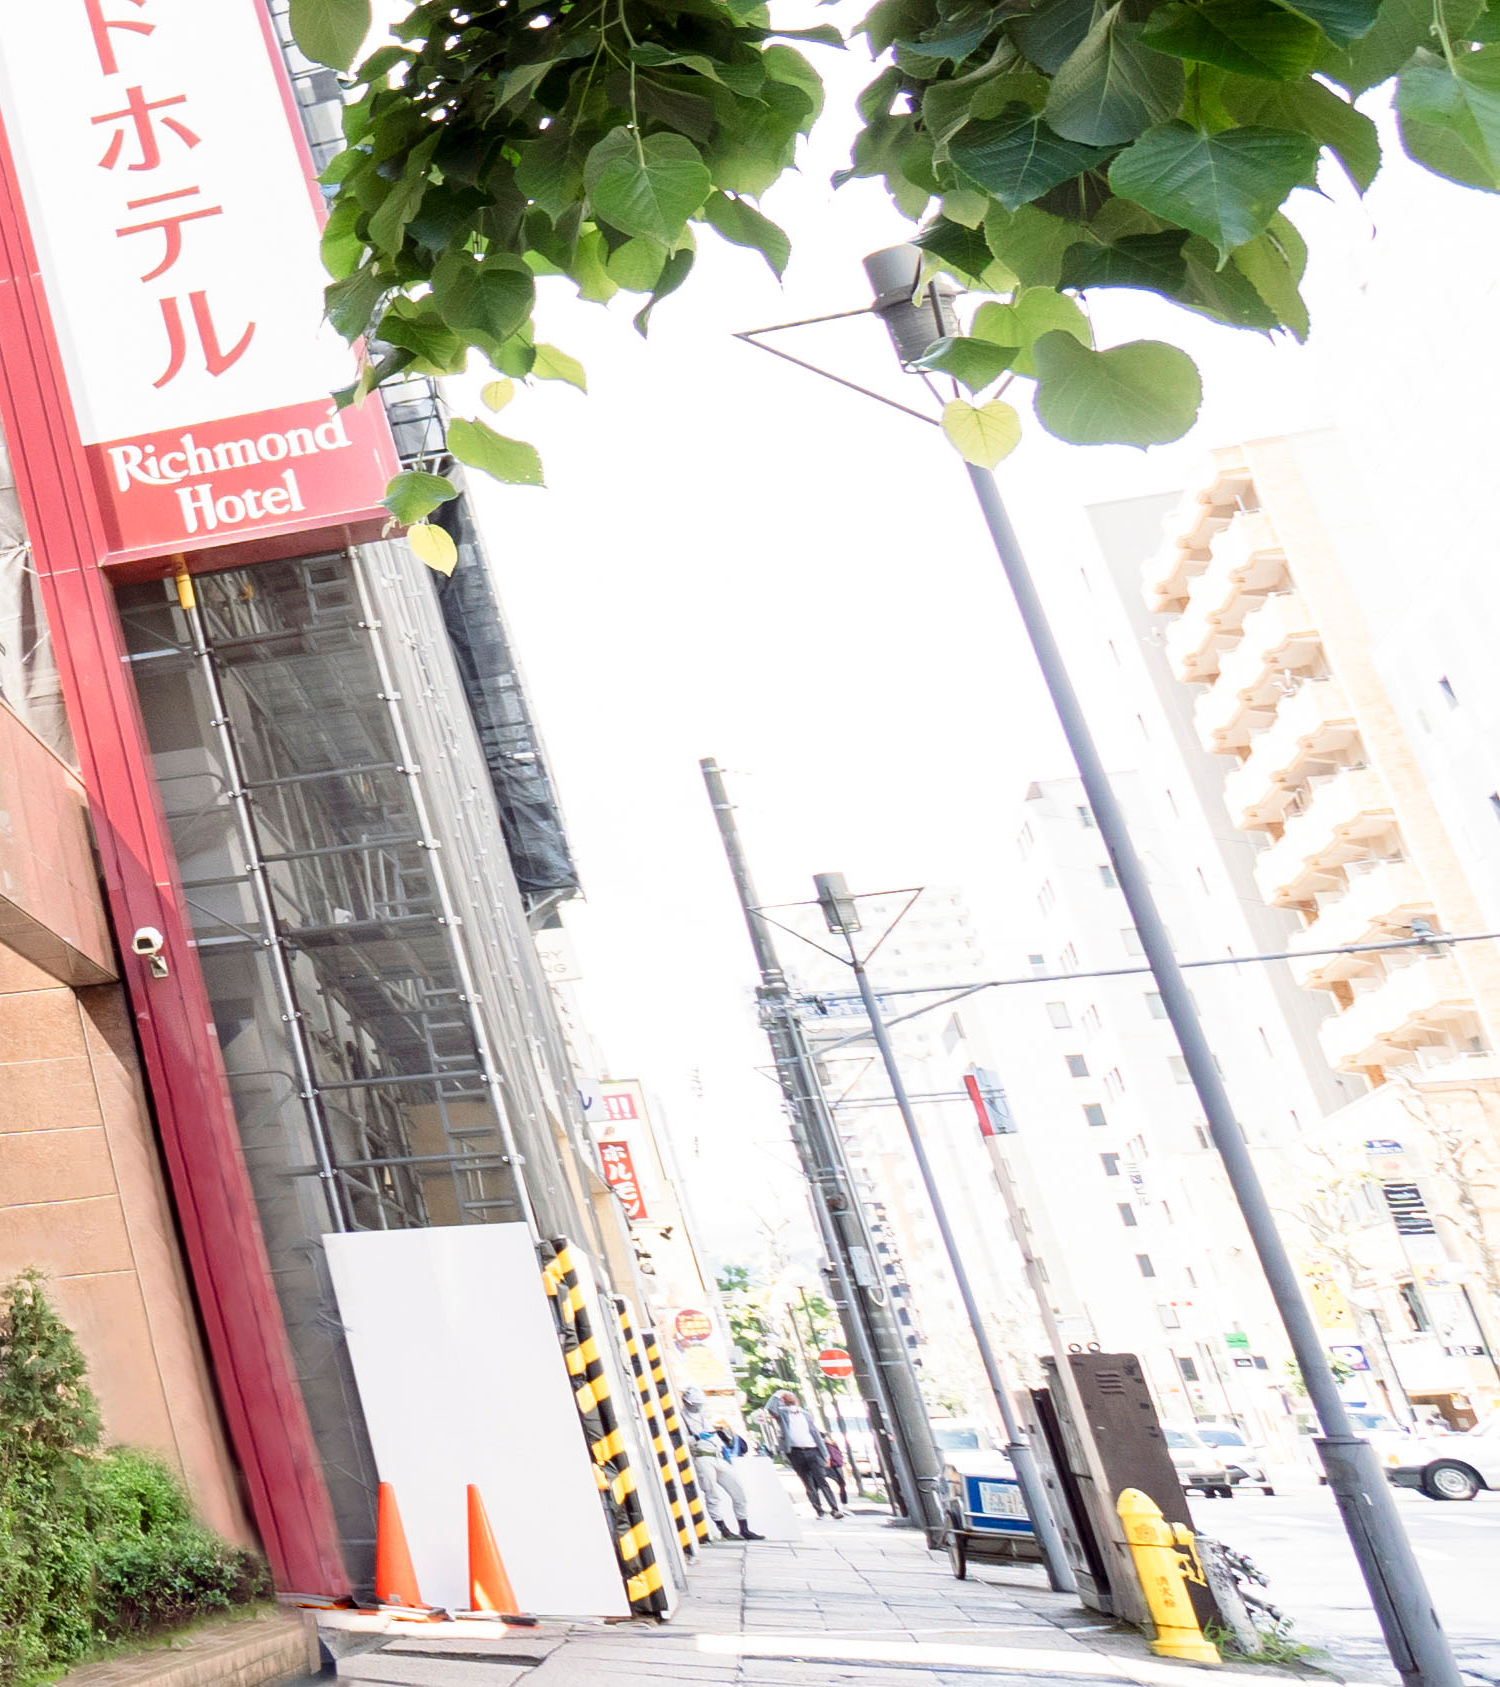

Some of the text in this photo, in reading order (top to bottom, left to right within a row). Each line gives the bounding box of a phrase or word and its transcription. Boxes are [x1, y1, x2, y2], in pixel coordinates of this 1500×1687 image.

[107, 405, 353, 493] Richmond
[175, 468, 306, 533] Hotel
[602, 1144, 640, 1217] ホルモン
